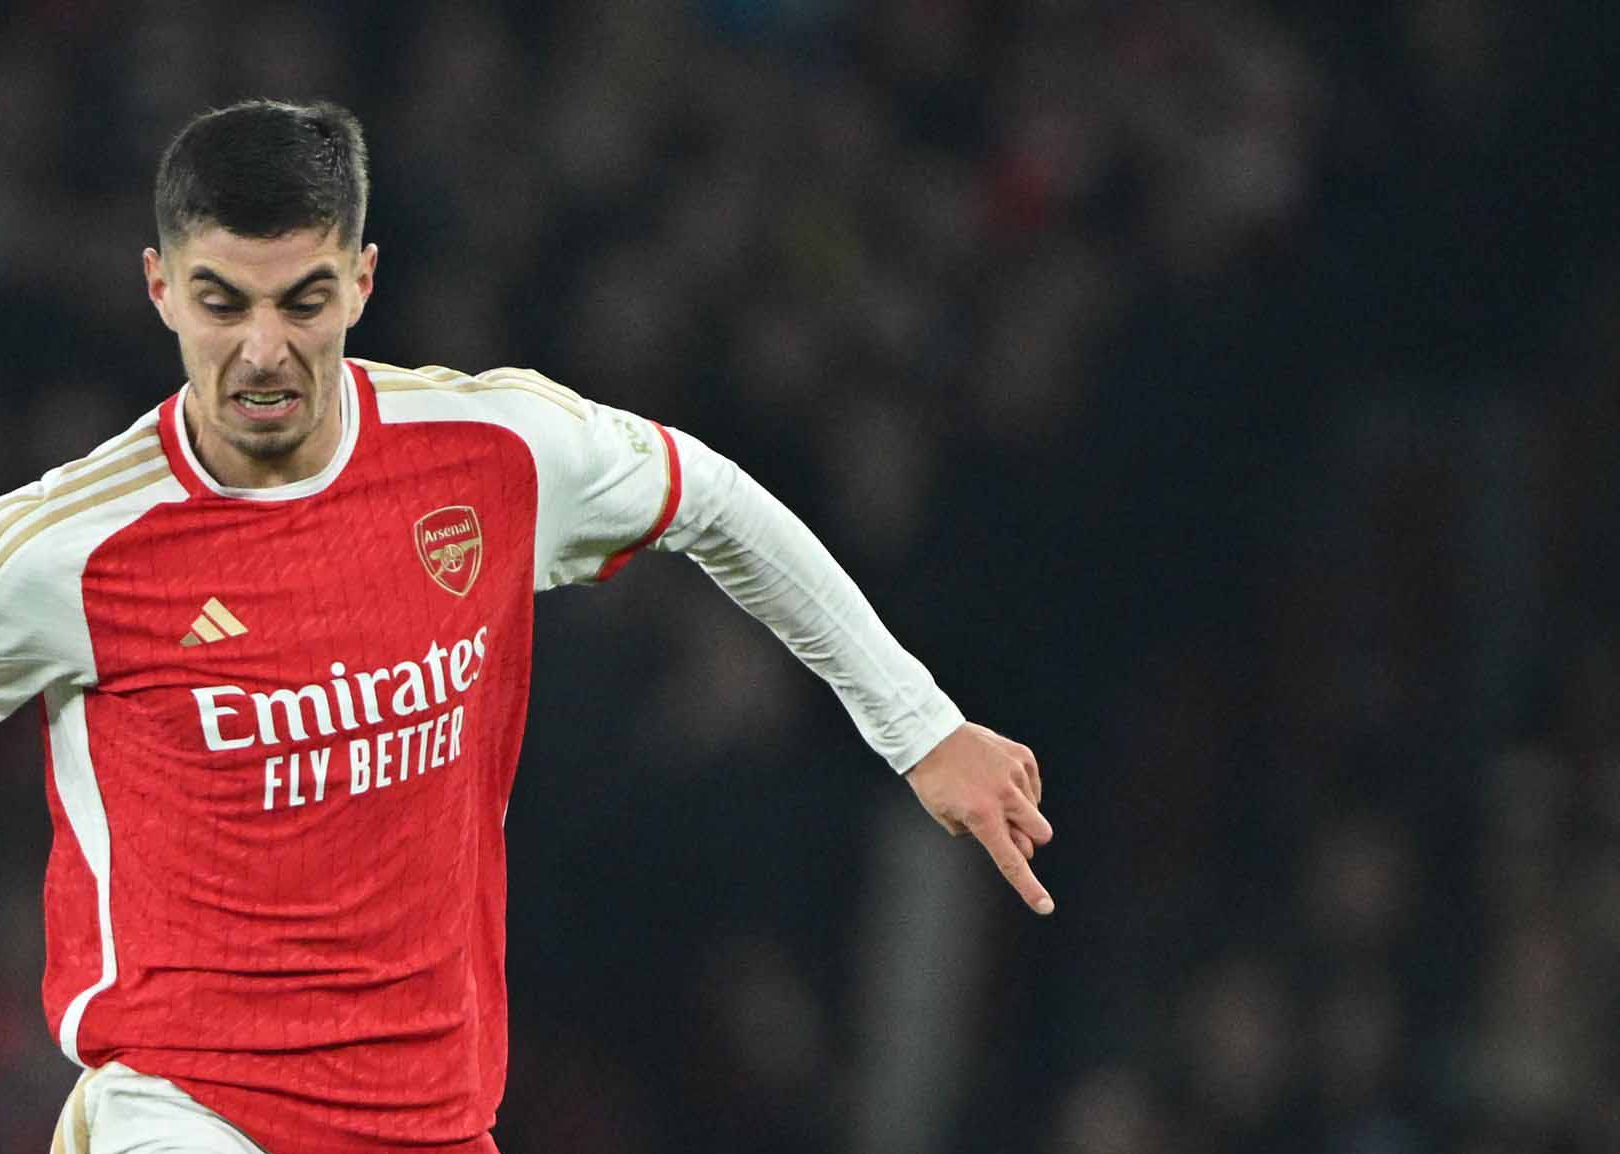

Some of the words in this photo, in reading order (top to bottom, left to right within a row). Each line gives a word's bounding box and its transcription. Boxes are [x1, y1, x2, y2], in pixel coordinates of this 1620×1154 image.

[424, 519, 472, 544] Arsenal
[191, 626, 488, 752] Emirates
[263, 747, 331, 811] FLY
[348, 705, 464, 796] BETTER
